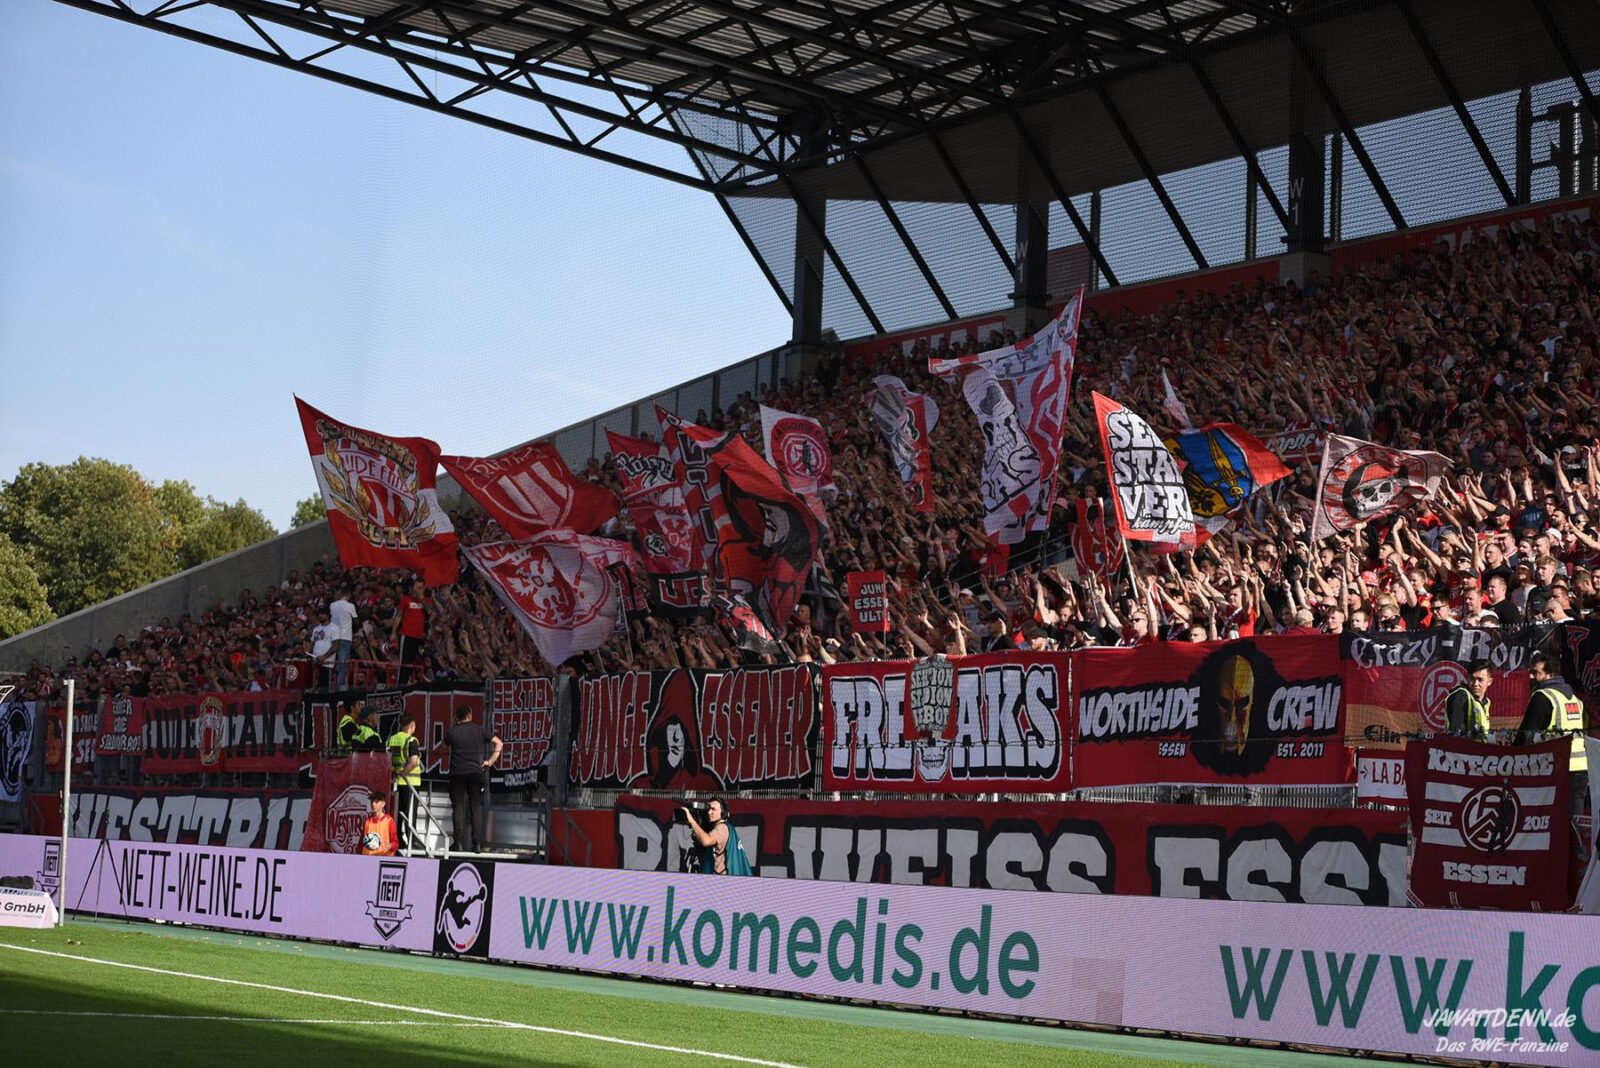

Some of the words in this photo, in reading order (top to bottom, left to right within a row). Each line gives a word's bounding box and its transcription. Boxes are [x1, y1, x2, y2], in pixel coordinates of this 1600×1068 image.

[1119, 486, 1194, 522] VER
[493, 678, 555, 711] SEKTION
[569, 671, 652, 784] JUNGE
[700, 664, 815, 784] ESSENER
[1078, 686, 1201, 743] NORTHSIDE
[1266, 682, 1342, 732] CREW
[1159, 742, 1186, 757] ESSEN
[1277, 742, 1298, 758] EST.
[1427, 747, 1555, 777] KATEGORIE
[1372, 761, 1389, 784] LA
[1424, 808, 1454, 825] SEIT
[119, 848, 287, 924] NETT-WEINE.DE
[1442, 861, 1527, 887] ESSEN
[4, 901, 46, 914] GmbH
[519, 883, 1041, 999] www.komedis.de
